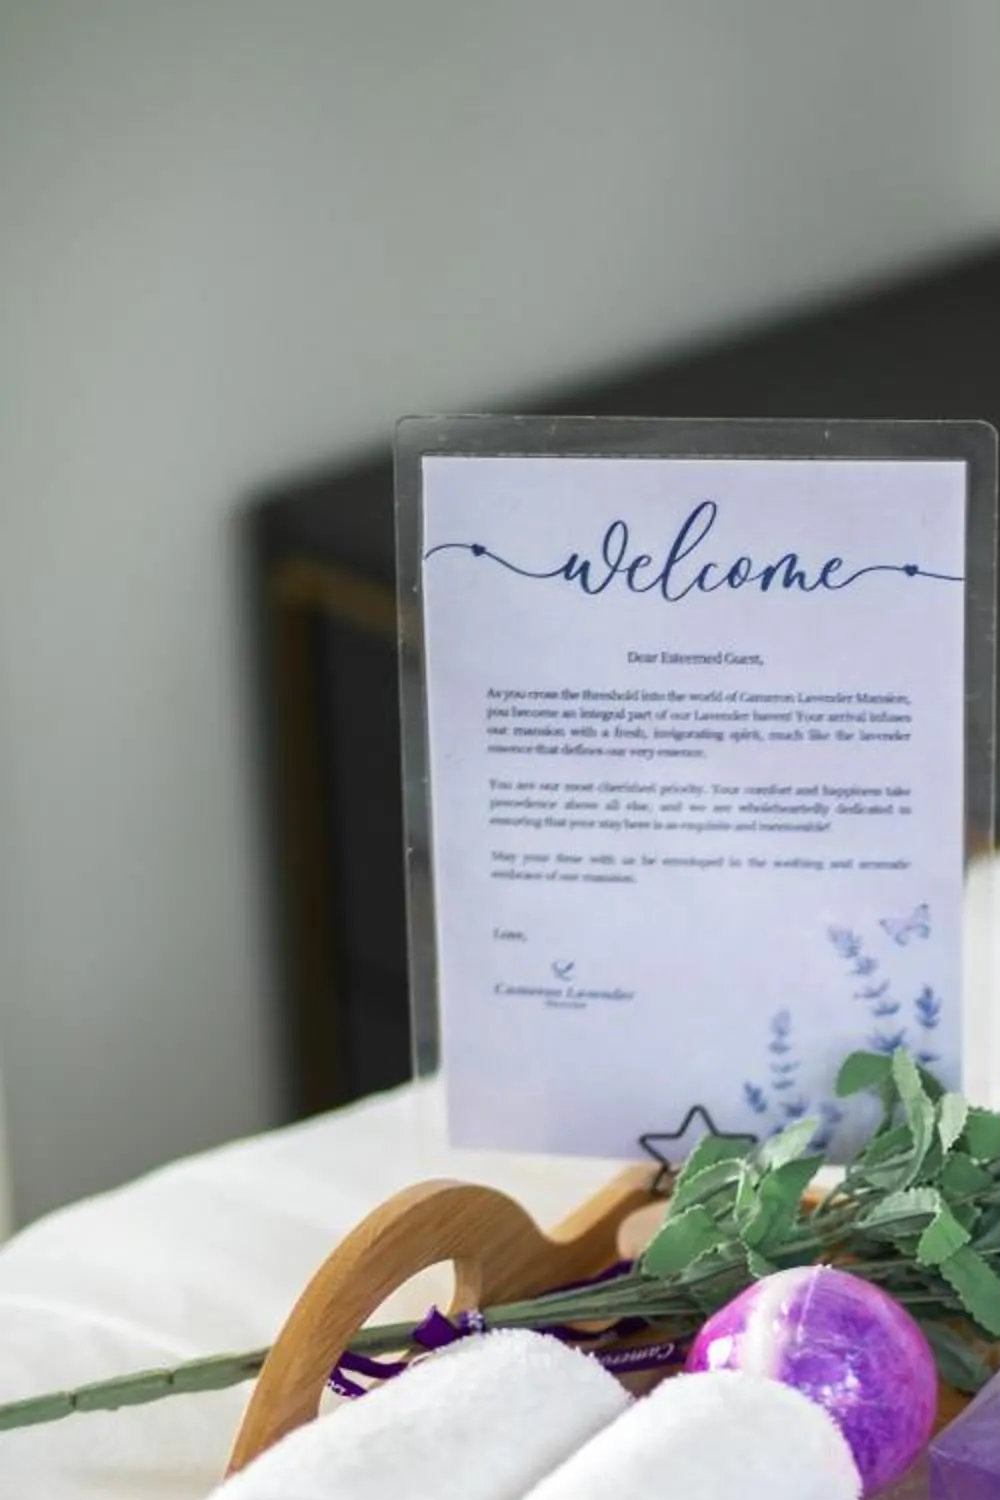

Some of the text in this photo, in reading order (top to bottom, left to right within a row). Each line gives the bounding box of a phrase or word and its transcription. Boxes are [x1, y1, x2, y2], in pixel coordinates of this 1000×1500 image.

[550, 500, 856, 602] welcome
[627, 651, 764, 666] Dear Esteemed Guest,
[487, 688, 501, 699] As
[502, 690, 525, 702] you
[561, 688, 579, 699] the
[582, 688, 638, 700] threshold
[641, 690, 665, 700] into
[667, 690, 686, 701] the
[689, 690, 723, 702] world
[725, 690, 738, 702] of
[740, 691, 795, 703] Cameron
[798, 692, 851, 704] Lavender
[856, 692, 912, 705] Mansion,
[512, 706, 558, 718] become
[562, 710, 577, 719] an
[579, 707, 625, 721] integral
[628, 710, 652, 722] part
[654, 709, 667, 720] of
[670, 711, 690, 720] our
[694, 710, 749, 721] Lavender
[796, 710, 825, 723] Your
[827, 710, 866, 722] arrival
[869, 711, 912, 723] infuses
[487, 727, 507, 736] our
[513, 726, 566, 737] mansion
[570, 726, 597, 737] with
[614, 726, 648, 739] fresh,
[654, 729, 724, 742] invigorating
[729, 729, 765, 744] spirit,
[768, 730, 804, 741] much
[835, 729, 854, 741] the
[859, 730, 911, 742] lavender
[535, 743, 559, 755] that
[561, 744, 603, 756] defines
[629, 748, 655, 761] very
[489, 779, 911, 799] You are our most cherished priority. Your comfort and happiness take
[738, 802, 830, 817] wholeheartedly
[835, 803, 893, 815] dedicated
[489, 816, 542, 830] ensuring
[544, 816, 566, 827] that
[491, 851, 517, 864] May
[494, 981, 635, 1001] Cameron Lavender
[600, 1343, 675, 1365] Camero
